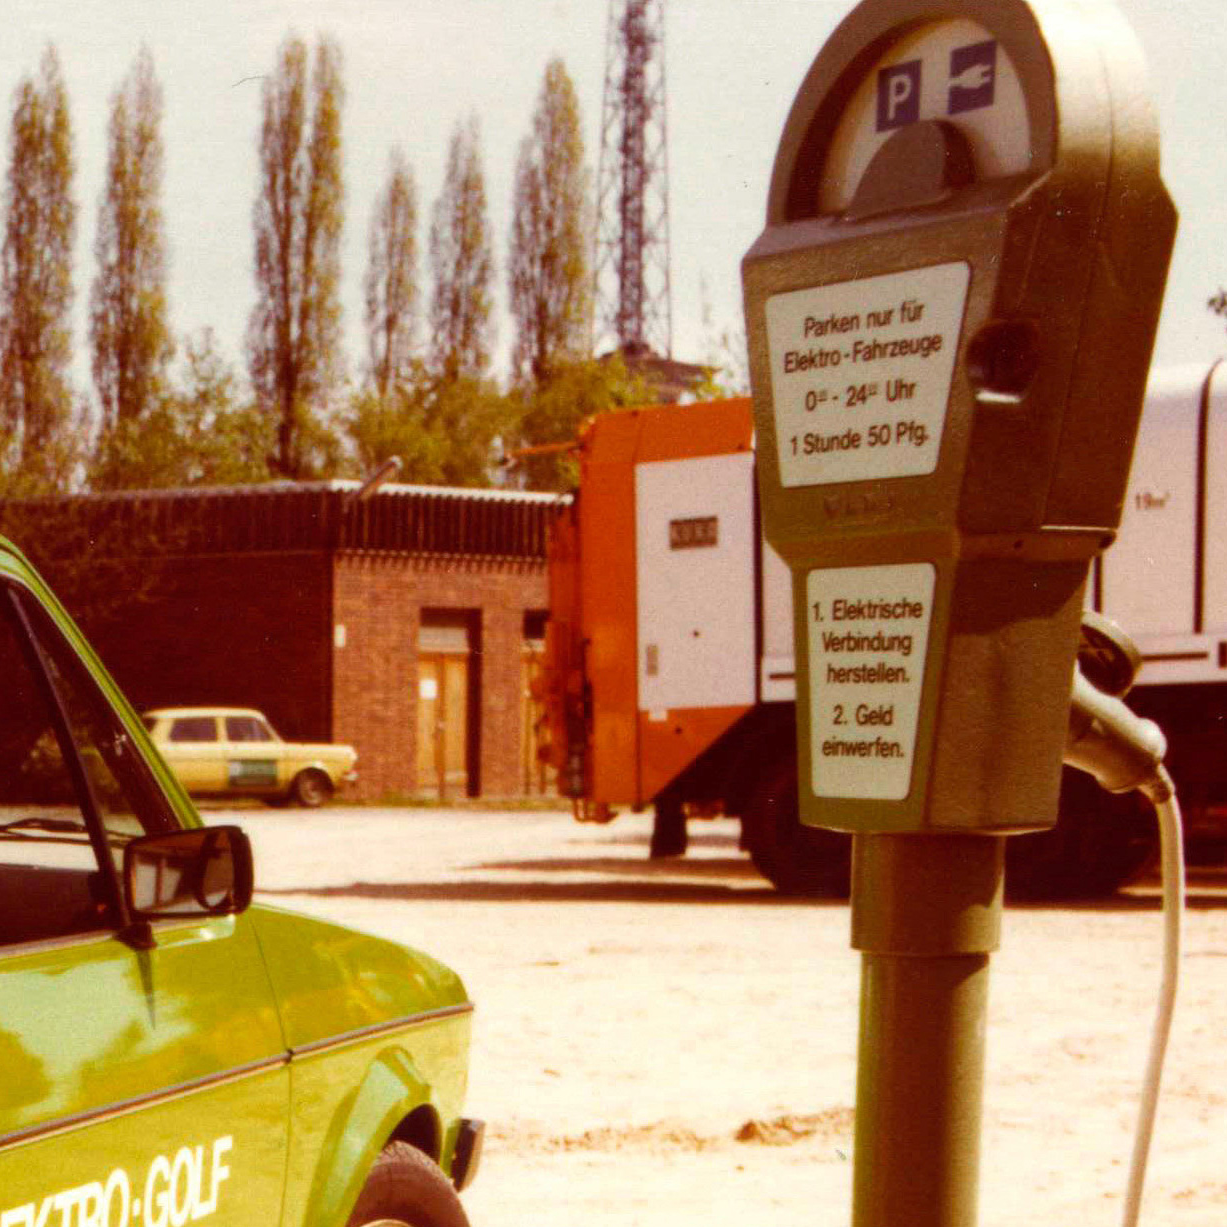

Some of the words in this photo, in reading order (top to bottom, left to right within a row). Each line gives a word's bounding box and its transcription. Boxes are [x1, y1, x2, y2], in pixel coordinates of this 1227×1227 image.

[888, 74, 912, 120] P
[804, 313, 860, 338] Parken
[866, 307, 895, 330] nur
[901, 299, 926, 324] für
[886, 378, 916, 403] Uhr
[791, 436, 797, 456] 1
[803, 428, 862, 455] Stunde
[868, 424, 891, 446] 50
[896, 420, 929, 447] Pfg.
[813, 602, 824, 622] 1.
[832, 597, 923, 621] Elektrische
[822, 631, 913, 657] Verbindung
[827, 662, 911, 684] herstellen.
[833, 704, 848, 726] 2.
[856, 703, 894, 726] Geld
[822, 735, 905, 759] einwerfen.
